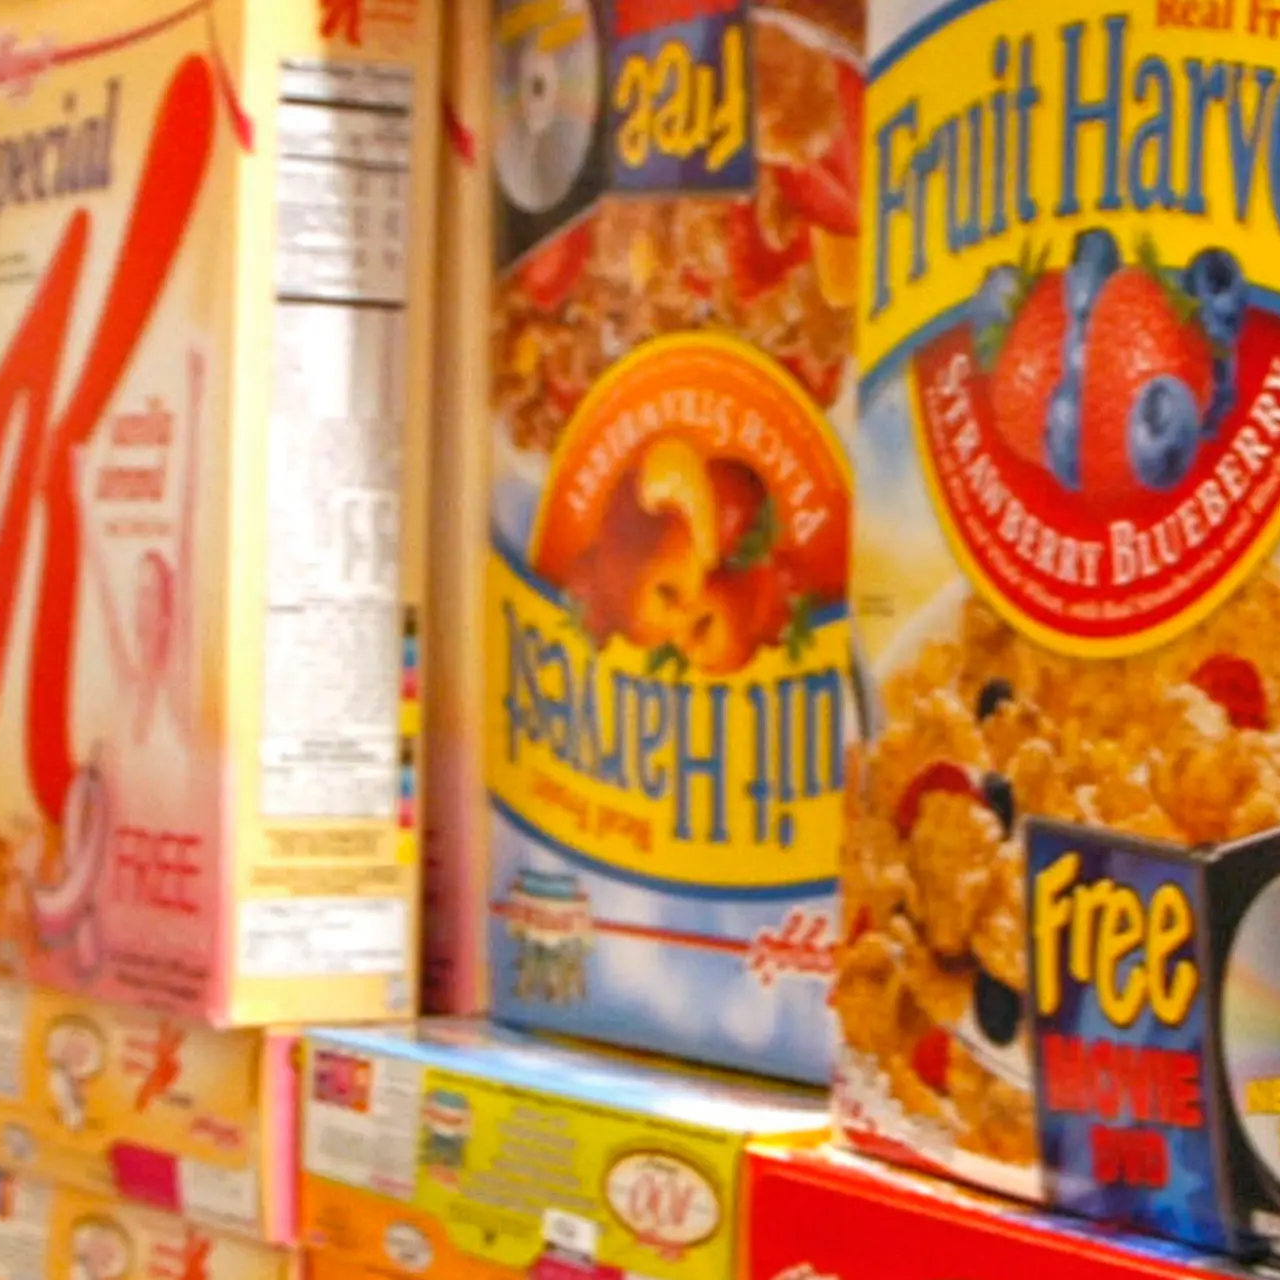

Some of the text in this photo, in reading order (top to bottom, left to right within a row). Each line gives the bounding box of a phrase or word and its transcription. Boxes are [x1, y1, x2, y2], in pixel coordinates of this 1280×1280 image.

[869, 31, 1042, 326] Fruit
[503, 596, 845, 849] uit Harvest
[1031, 849, 1200, 1030] Free
